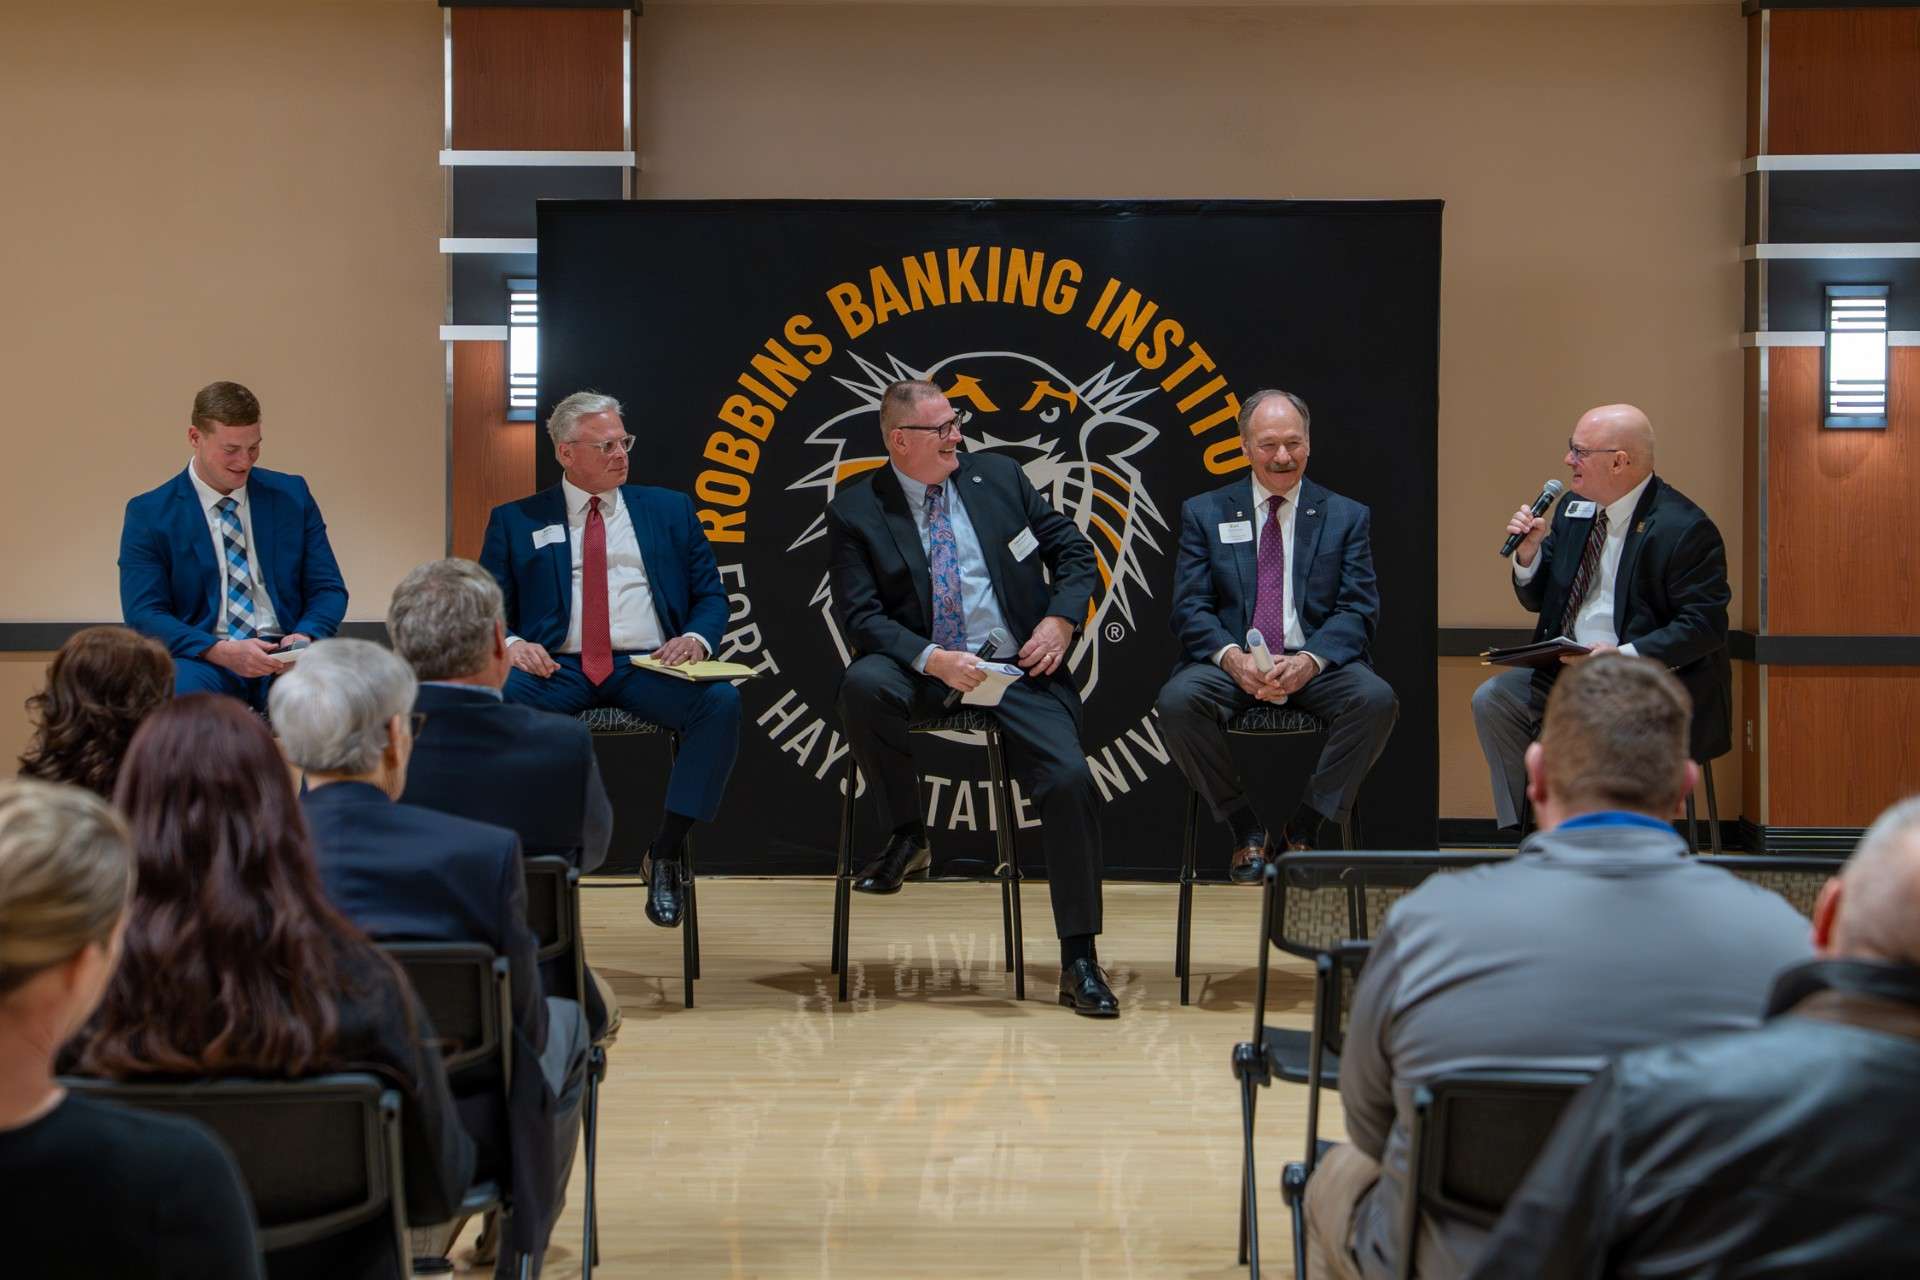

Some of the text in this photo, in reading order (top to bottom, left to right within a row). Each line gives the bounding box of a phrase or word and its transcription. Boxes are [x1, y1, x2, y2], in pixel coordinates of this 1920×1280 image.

[695, 246, 1252, 543] ROBBINS BANKING INSTITU
[917, 774, 1042, 832] TATE
